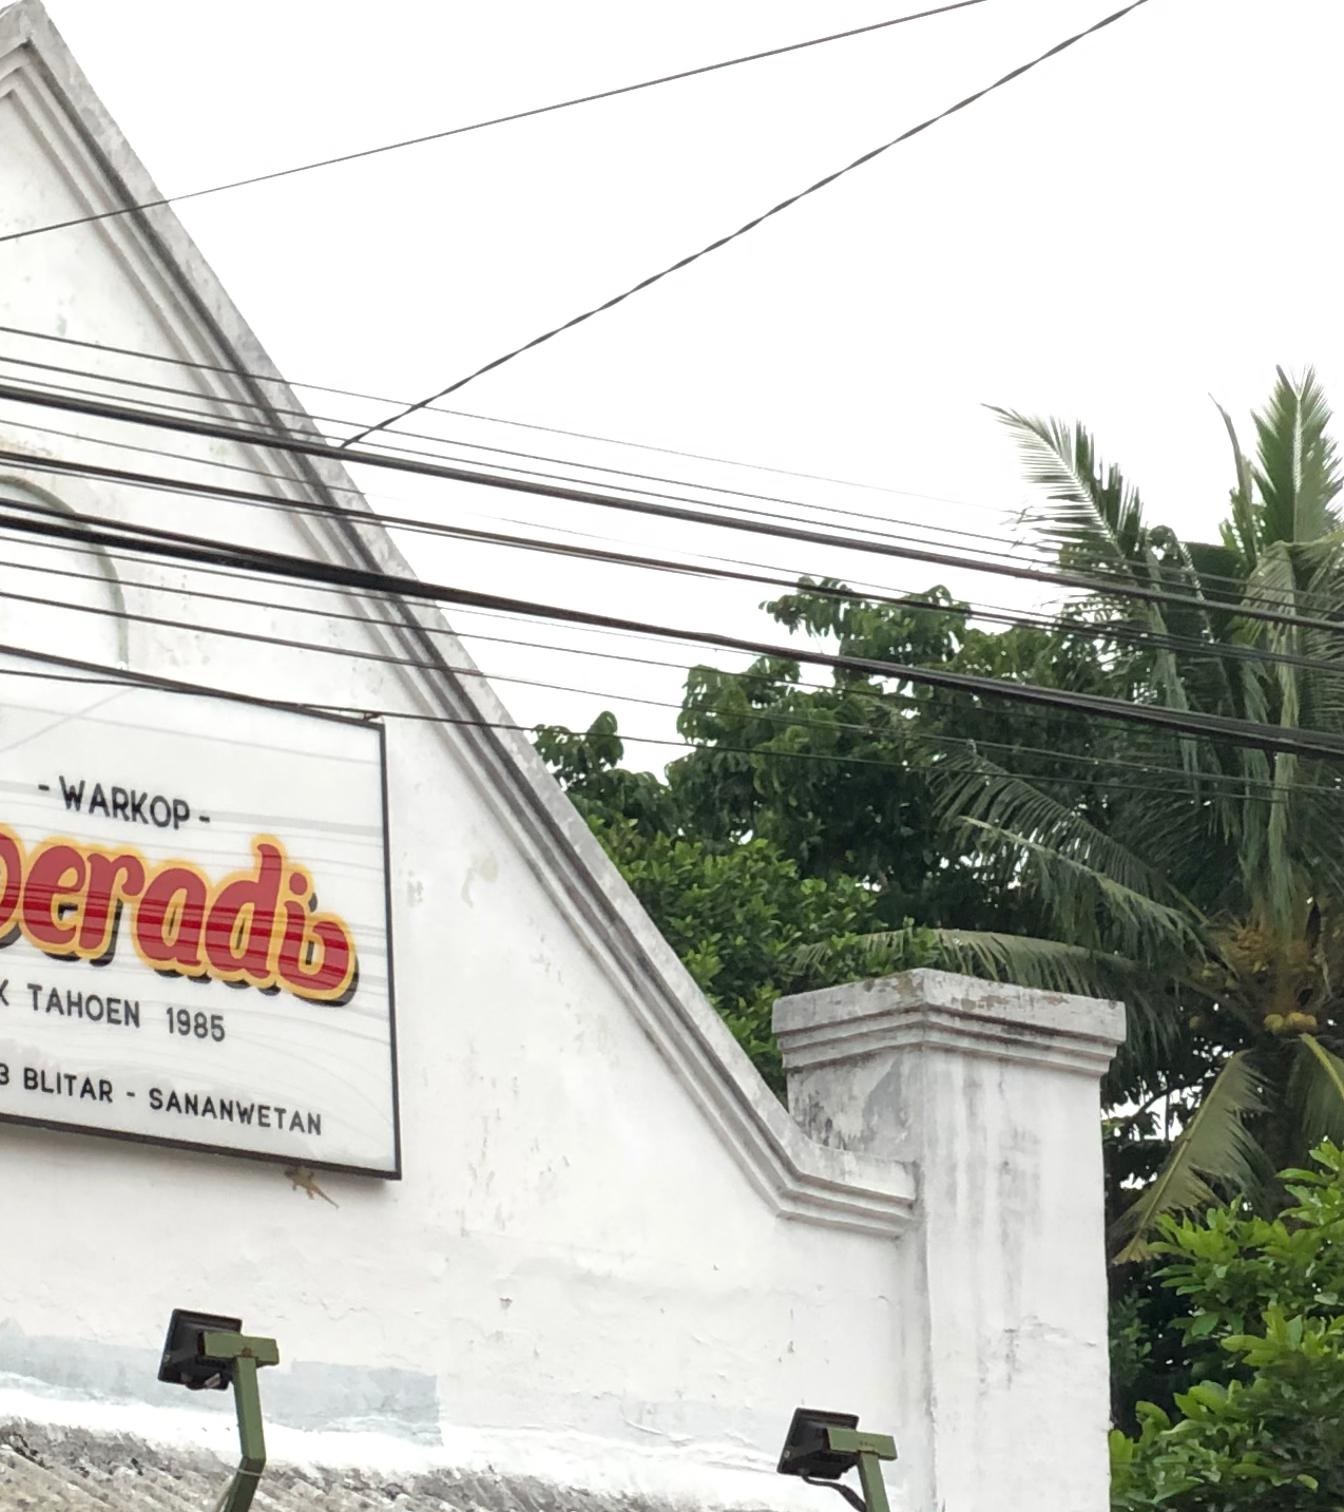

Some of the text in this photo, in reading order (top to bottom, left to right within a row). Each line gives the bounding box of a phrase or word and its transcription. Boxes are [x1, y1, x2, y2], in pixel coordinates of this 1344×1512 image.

[27, 983, 140, 1028] TAHOEN
[166, 1006, 226, 1042] 1985
[23, 1067, 113, 1104] BLITAR
[148, 1087, 322, 1136] SANANWETAN
